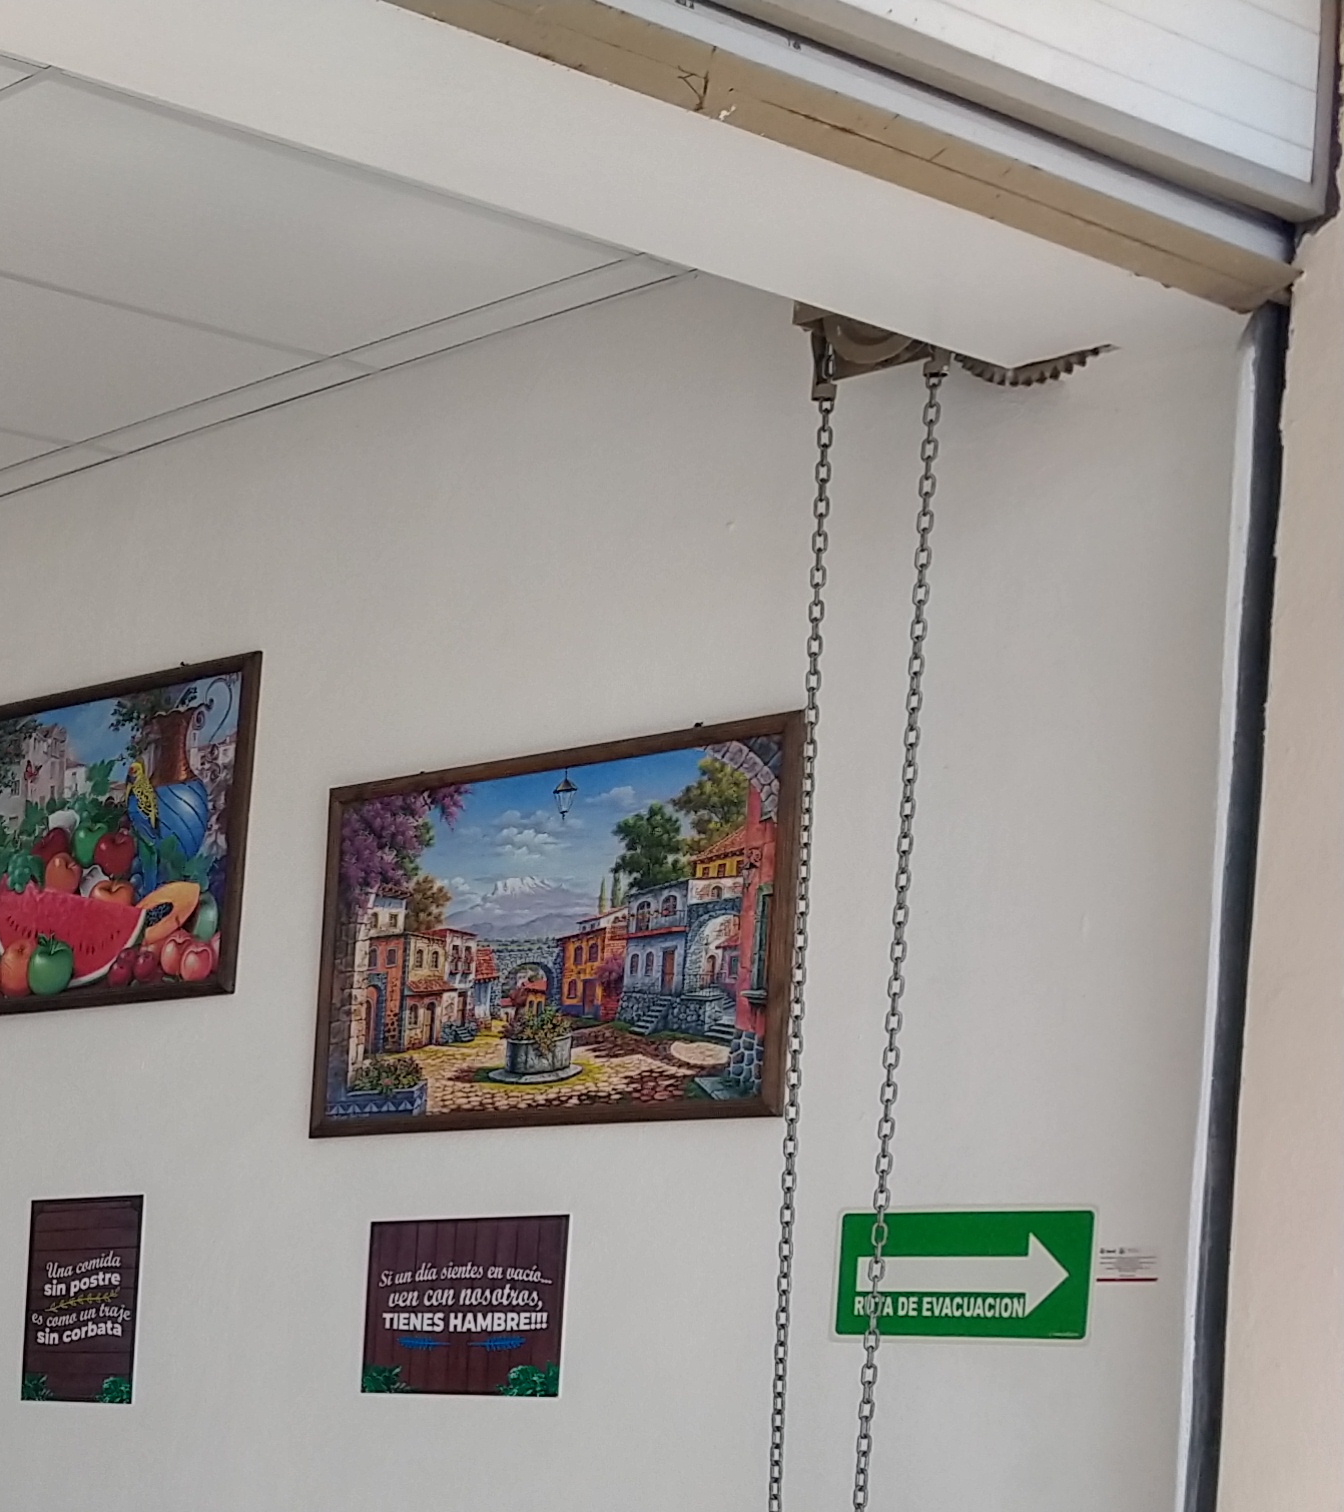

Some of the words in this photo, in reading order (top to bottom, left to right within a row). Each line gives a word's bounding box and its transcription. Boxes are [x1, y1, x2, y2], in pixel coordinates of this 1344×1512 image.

[46, 1261, 73, 1279] Una
[75, 1250, 121, 1274] comida
[379, 1269, 393, 1287] Si
[394, 1271, 412, 1284] un
[415, 1262, 438, 1282] día
[440, 1261, 484, 1280] sientes
[487, 1266, 504, 1279] en
[506, 1264, 553, 1285] vacío...
[43, 1279, 66, 1296] sin
[69, 1271, 121, 1297] postre
[388, 1289, 419, 1307] ven
[423, 1288, 456, 1305] con
[459, 1283, 543, 1310] nosotros,
[31, 1312, 43, 1325] es
[46, 1313, 77, 1327] como
[79, 1307, 97, 1321] un
[99, 1303, 132, 1323] traje
[897, 1296, 919, 1316] DE
[922, 1296, 1024, 1318] EVACUACION
[36, 1327, 59, 1345] sin
[62, 1320, 122, 1343] corbata
[382, 1312, 445, 1332] TIENES
[449, 1312, 549, 1333] HAMBRE!!!
